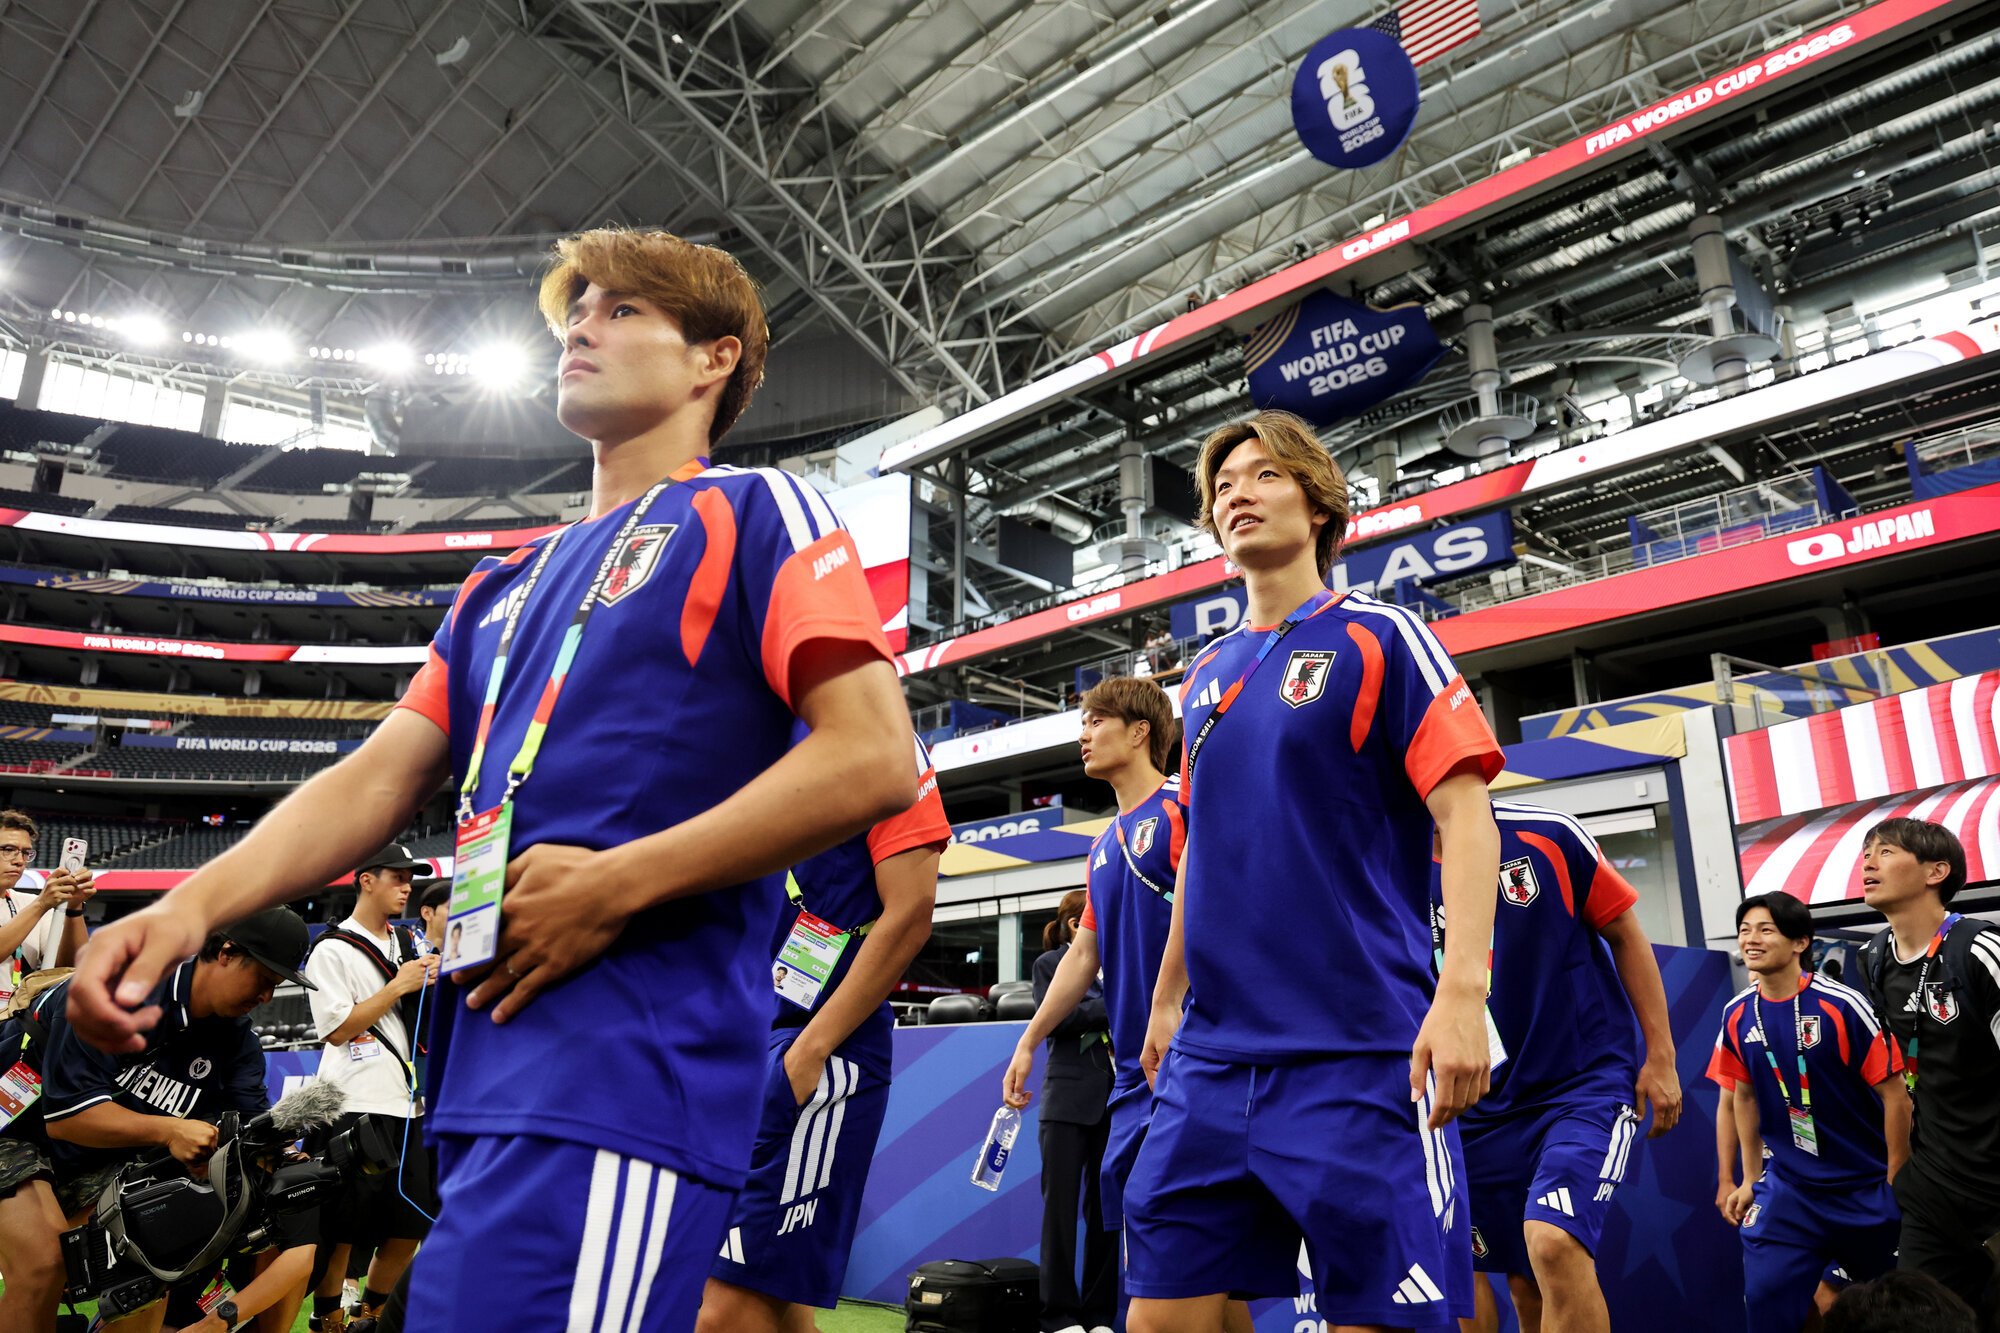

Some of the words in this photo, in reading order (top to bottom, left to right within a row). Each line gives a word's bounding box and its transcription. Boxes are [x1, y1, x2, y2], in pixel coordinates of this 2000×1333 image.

[1585, 124, 1632, 154] FIFA
[1632, 88, 1713, 133] WORLD
[1715, 65, 1762, 96] CUP
[1765, 25, 1852, 76] 2026
[1344, 107, 1364, 121] FIFA
[1339, 124, 1366, 141] WORLD
[1365, 117, 1380, 130] CUP
[1342, 124, 1385, 153] 2026
[1310, 318, 1359, 349] FIFA
[1279, 342, 1358, 382] WORLD
[1360, 324, 1405, 355] CUP
[1308, 357, 1388, 397] 2026
[632, 527, 660, 536] APAN
[1846, 509, 1936, 553] JAPAN
[580, 582, 602, 610] FIFA
[594, 538, 625, 583] WORLD
[620, 515, 639, 538] CUP
[813, 545, 849, 580] JAPAN
[170, 585, 198, 597] FIFA
[201, 587, 247, 600] WORLD
[248, 589, 273, 600] CUP
[273, 590, 317, 602] 2026
[520, 578, 537, 600] CUP
[1196, 526, 1489, 635] DLAS
[501, 600, 526, 643] 2026
[83, 636, 110, 648] FIFA
[111, 638, 156, 652] WORLD
[156, 641, 182, 653] CUP
[1289, 688, 1308, 697] JFA
[1200, 718, 1214, 736] FIFA
[176, 737, 207, 750] FIFA
[209, 738, 259, 751] WORLD
[259, 739, 288, 752] CUP
[288, 740, 337, 753] 2026
[1189, 737, 1203, 766] WORLD
[917, 775, 937, 802] JAPAN
[1504, 860, 1522, 869] JAPAN
[1916, 976, 1925, 998] WORLD
[994, 1129, 1012, 1167] smart
[288, 1185, 315, 1199] FUJINON
[777, 1198, 818, 1236] JPN
